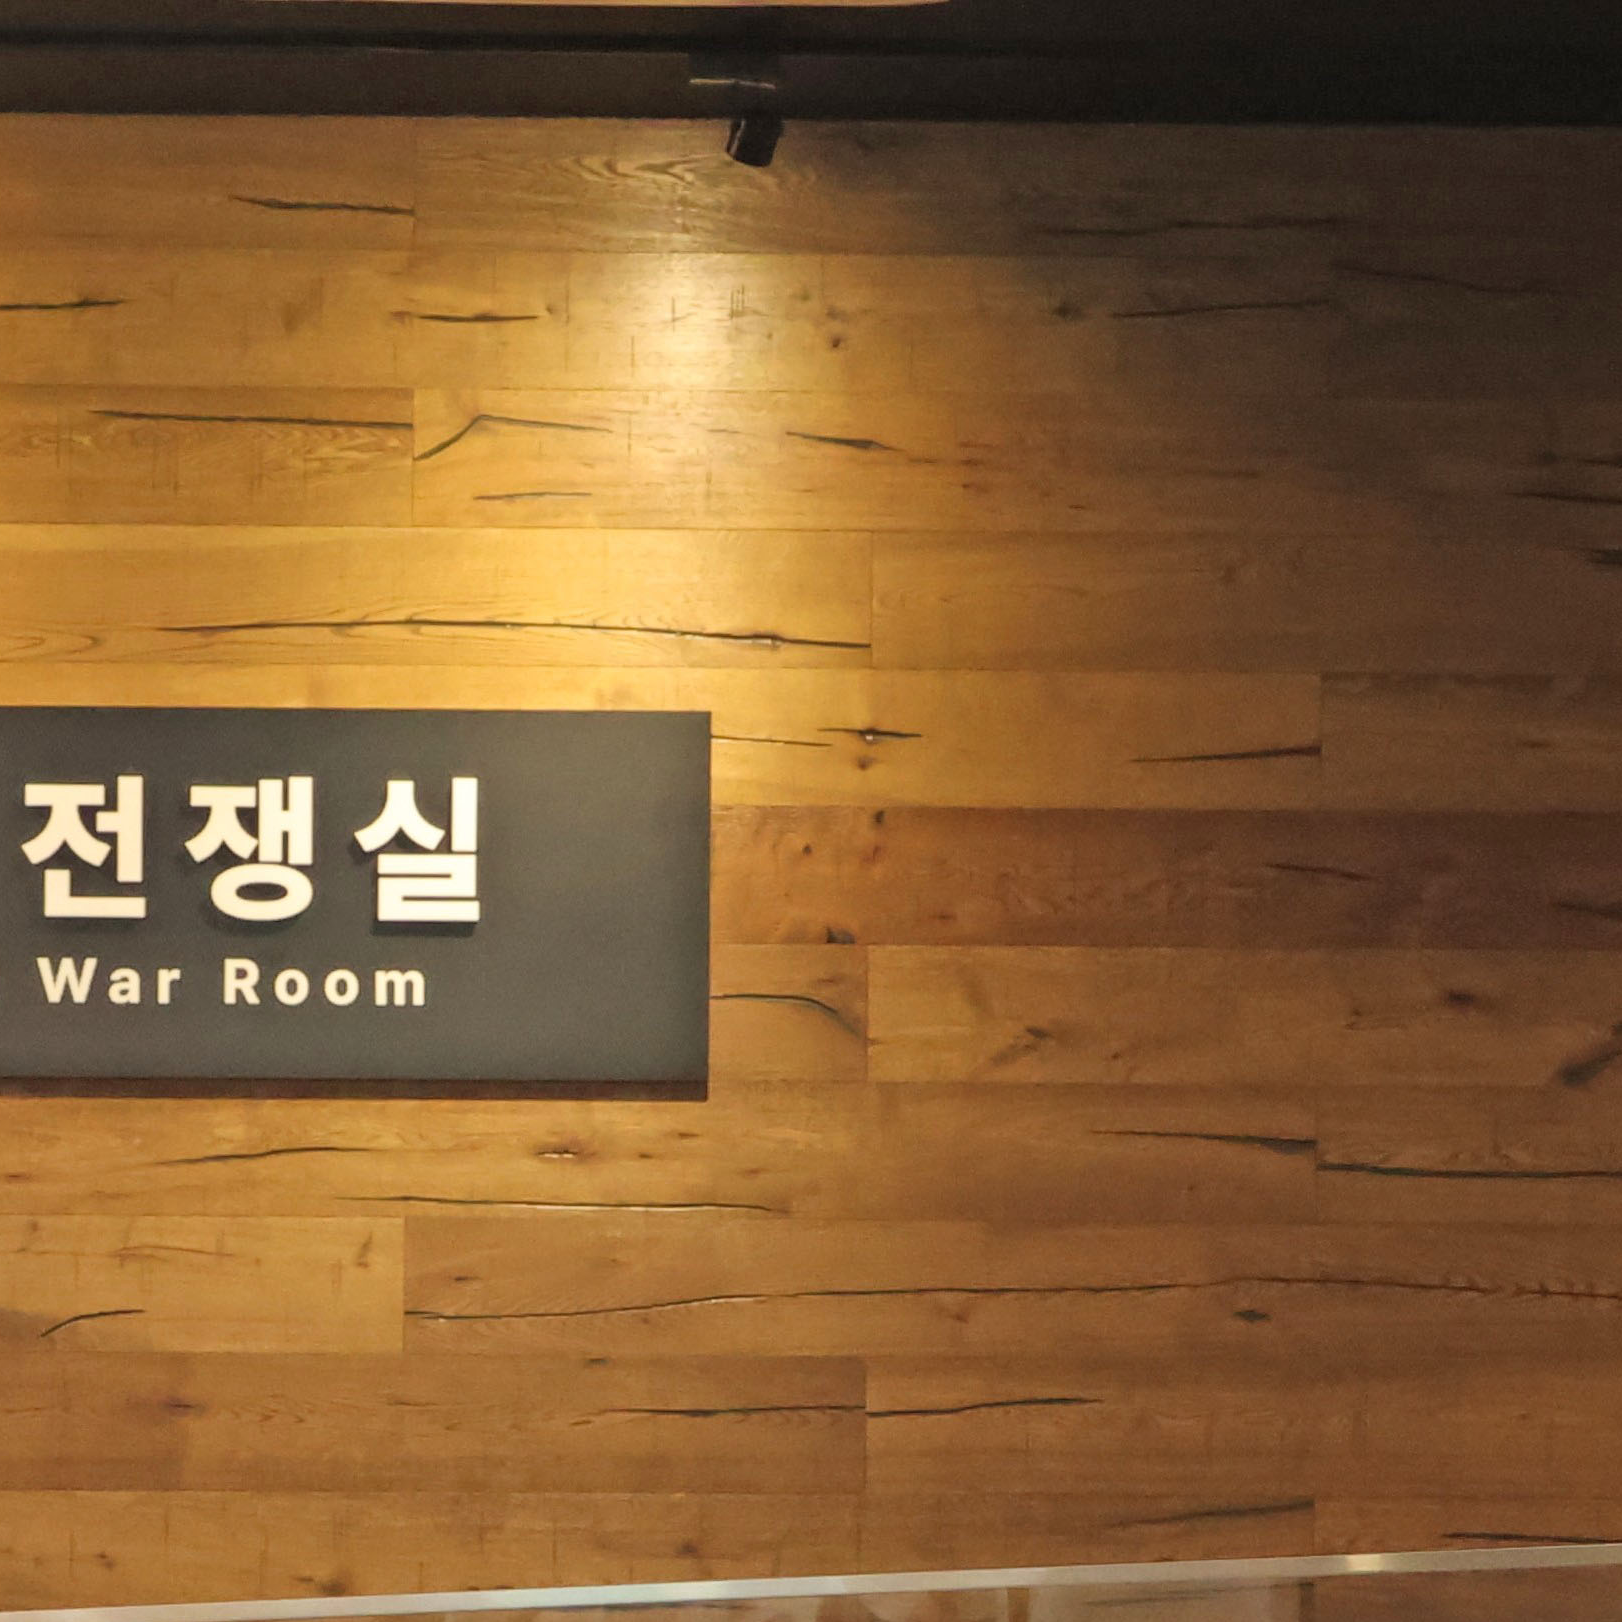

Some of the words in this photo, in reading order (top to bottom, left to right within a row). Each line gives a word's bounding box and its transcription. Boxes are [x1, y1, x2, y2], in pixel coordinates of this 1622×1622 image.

[21, 775, 481, 922] 전쟁실
[36, 957, 181, 1005] War
[223, 958, 425, 1007] Room
